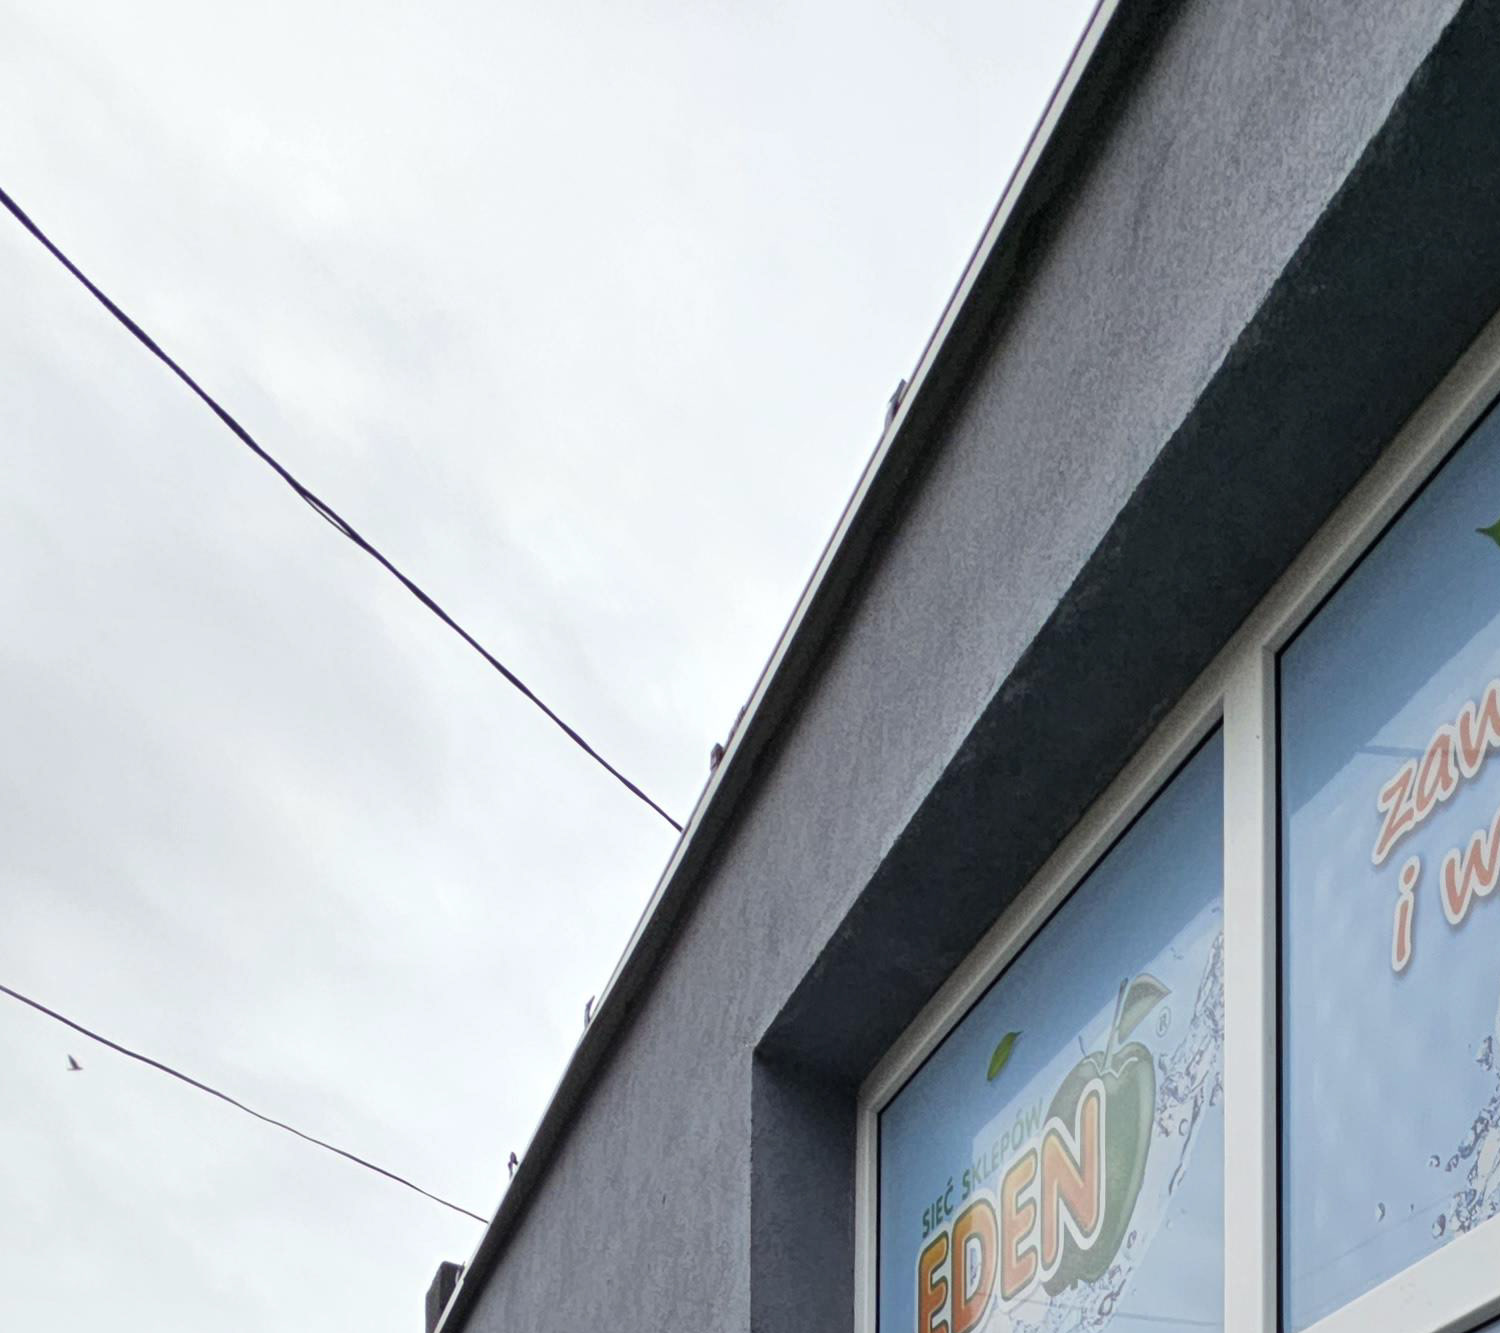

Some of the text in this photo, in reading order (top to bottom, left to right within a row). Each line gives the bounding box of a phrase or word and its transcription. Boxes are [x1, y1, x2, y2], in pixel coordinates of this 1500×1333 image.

[1391, 856, 1420, 970] i
[922, 1097, 1043, 1239] SIEĆ SKLEPÓW
